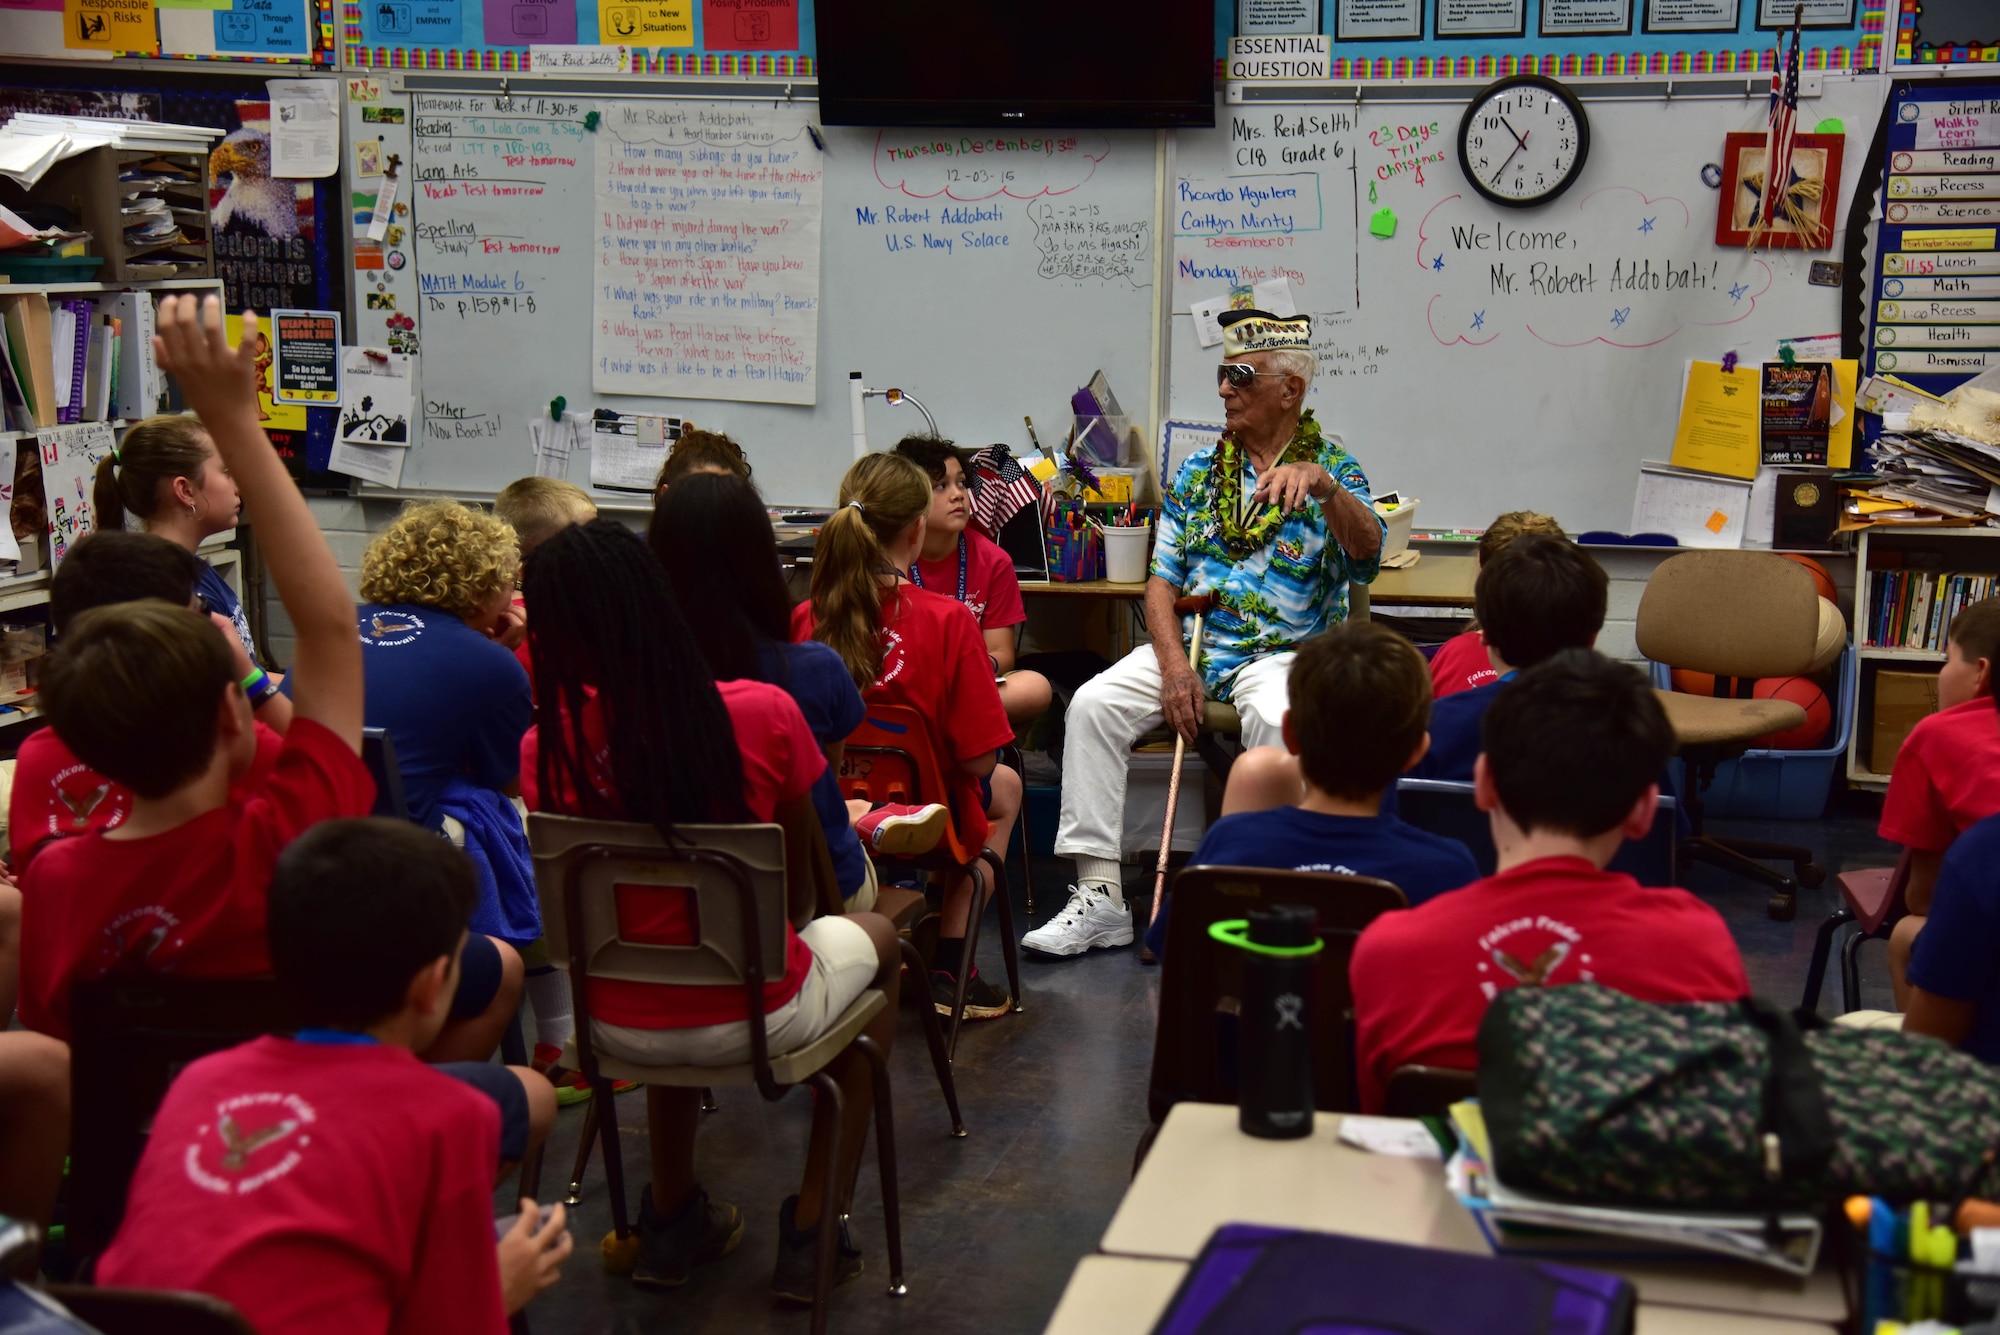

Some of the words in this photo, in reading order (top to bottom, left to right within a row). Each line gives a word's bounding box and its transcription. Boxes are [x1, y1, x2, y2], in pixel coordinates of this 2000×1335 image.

[242, 0, 273, 10] Data
[114, 12, 142, 24] Risks
[263, 14, 293, 25] Through
[648, 9, 657, 17] to
[660, 9, 679, 17] New
[416, 17, 451, 25] EMPATHY
[643, 23, 687, 32] Situations
[273, 25, 283, 34] All
[266, 37, 292, 46] Senses
[1235, 38, 1325, 54] ESSENTIAL
[1233, 61, 1323, 79] QUESTION
[417, 94, 465, 112] Homework
[493, 98, 518, 114] Week
[522, 99, 533, 112] of
[537, 99, 578, 115] 11-30-15
[1498, 101, 1510, 114] 11
[1519, 95, 1533, 108] 12
[1545, 102, 1548, 114] 1
[1949, 101, 1985, 115] Silent
[648, 111, 689, 126] Robert
[1484, 117, 1498, 129] 10
[1557, 117, 1565, 131] 2
[1934, 117, 1965, 128] Walk
[1967, 116, 1979, 126] to
[493, 119, 512, 134] Lola
[516, 122, 541, 134] Came
[548, 122, 559, 134] To
[1233, 117, 1265, 141] Mrs.
[1938, 129, 1975, 138] Learn
[705, 128, 732, 141] Harbor
[1369, 126, 1393, 147] 23
[1398, 122, 1438, 141] Days
[462, 143, 485, 155] LTT
[506, 142, 552, 156] 180-193
[1474, 136, 1482, 149] 9
[1560, 138, 1568, 150] 3
[624, 144, 646, 158] How
[654, 149, 683, 166] many
[731, 149, 742, 163] do
[747, 152, 763, 169] you
[1237, 147, 1267, 166] C18
[1282, 144, 1325, 164] Grade
[1334, 140, 1343, 158] 6
[502, 155, 525, 167] Test
[529, 156, 576, 167] tomorrow
[1377, 151, 1445, 180] Christmas
[1479, 155, 1488, 169] 8
[1552, 157, 1560, 169] 4
[1943, 152, 1995, 170] Reading
[454, 164, 478, 178] Arts
[1515, 177, 1523, 190] 6
[1535, 172, 1543, 185] 5
[1940, 178, 1985, 191] Recess
[424, 183, 457, 200] Vocab
[462, 182, 487, 196] Test
[493, 185, 543, 196] tomorrow
[772, 186, 801, 206] family
[1178, 180, 1234, 202] Ricardo
[1240, 186, 1296, 207] Aguilera
[856, 206, 880, 226] Mr.
[886, 204, 930, 223] Robert
[940, 203, 1003, 224] Addobati
[1937, 205, 1992, 217] Science
[1181, 211, 1234, 234] Caitlyn
[1241, 213, 1293, 233] Minty
[416, 219, 476, 244] Spelling
[1452, 222, 1578, 251] Welcome,
[435, 241, 468, 257] Study
[478, 238, 503, 254] Test
[508, 242, 560, 255] tomorrow
[616, 235, 639, 249] Were
[675, 240, 692, 257] any
[885, 233, 916, 252] U.S.
[924, 233, 952, 254] Navy
[964, 231, 1010, 247] Solace
[737, 256, 759, 272] Have
[762, 260, 780, 276] you
[1906, 259, 1934, 275] 11:55
[1936, 255, 1976, 268] Lunch
[421, 273, 457, 292] MATH
[462, 274, 506, 290] Module
[515, 270, 525, 290] 6
[1241, 266, 1267, 285] Kyle
[1491, 263, 1518, 296] Mr.
[1530, 262, 1597, 295] Robert
[1610, 258, 1718, 293] Addobati!
[1933, 278, 1970, 291] Math
[613, 286, 637, 301] What
[429, 296, 445, 312] Do
[1930, 302, 1976, 316] Recess
[614, 321, 639, 337] What
[644, 328, 663, 340] was
[670, 322, 693, 341] Pearl
[698, 324, 730, 343] Harbor
[735, 325, 752, 343] like
[757, 327, 796, 346] before
[1928, 328, 1970, 340] Health
[1267, 338, 1293, 348] Harbor
[1927, 353, 1986, 366] Dismissal
[291, 365, 300, 373] So
[301, 365, 310, 373] Be
[311, 366, 326, 374] Cool
[676, 359, 692, 375] like
[1768, 367, 1816, 383] Tower
[426, 401, 466, 419] Other
[376, 421, 382, 430] 6
[455, 421, 483, 438] Book
